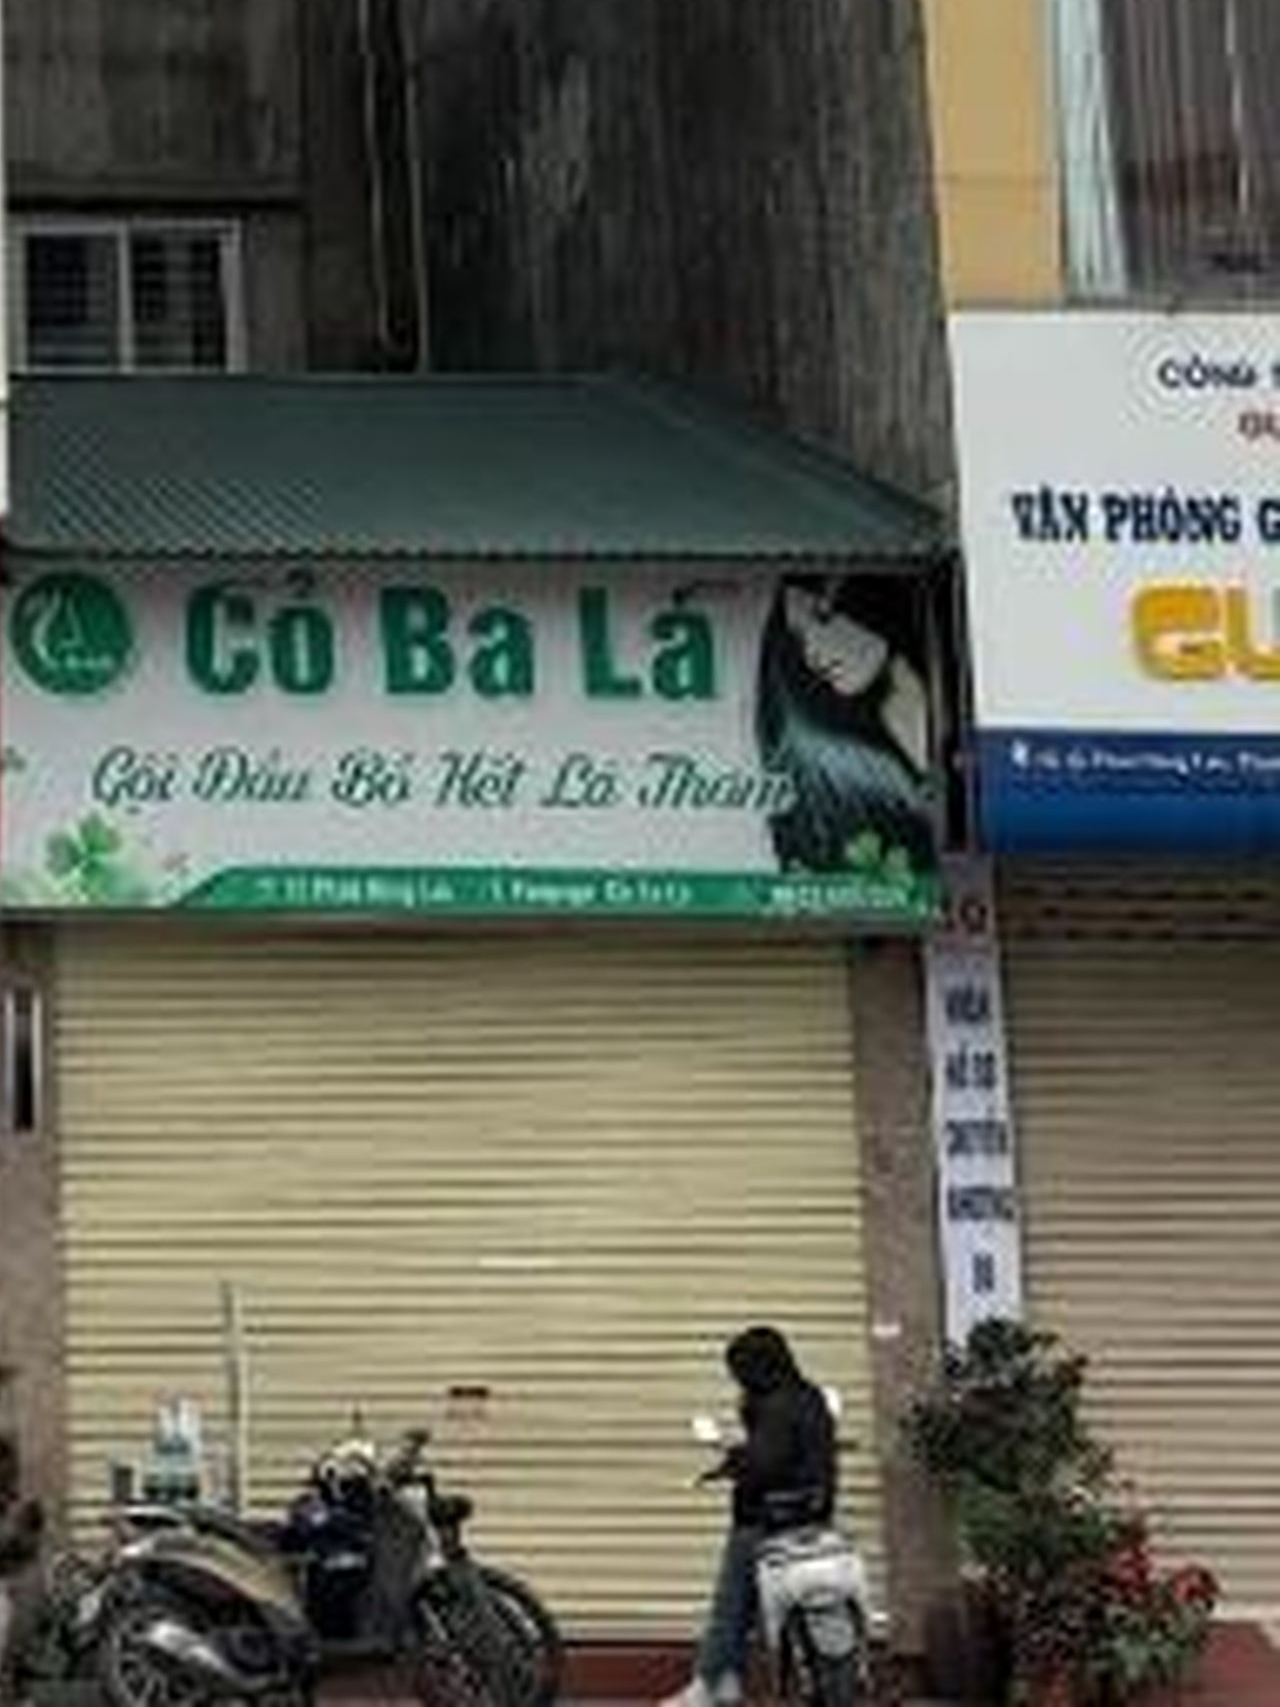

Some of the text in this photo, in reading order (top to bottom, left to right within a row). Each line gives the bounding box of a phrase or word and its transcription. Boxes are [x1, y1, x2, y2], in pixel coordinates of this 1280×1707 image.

[1102, 488, 1241, 543] PHÒNG
[380, 587, 536, 695] Ba
[580, 582, 717, 699] Lá
